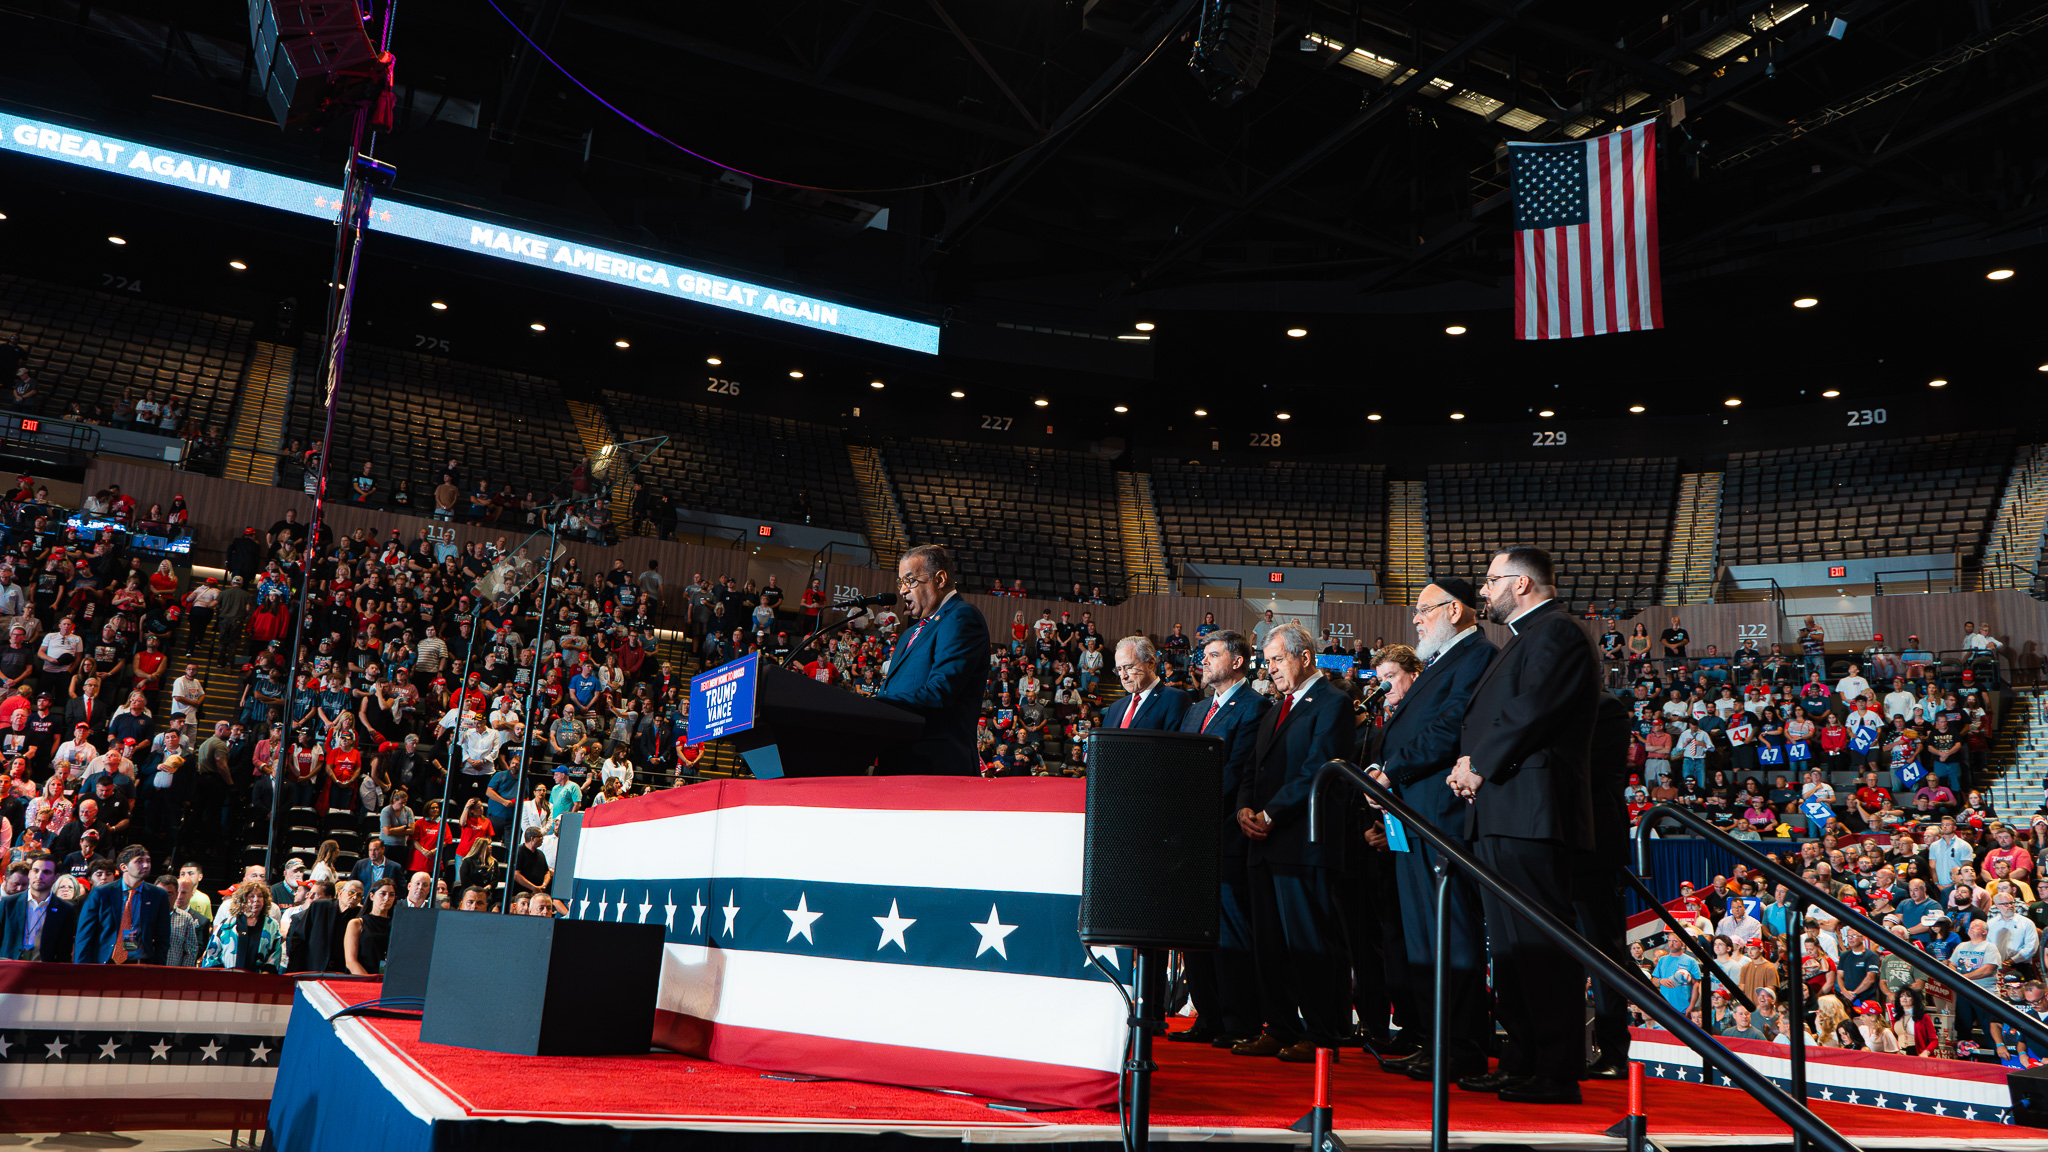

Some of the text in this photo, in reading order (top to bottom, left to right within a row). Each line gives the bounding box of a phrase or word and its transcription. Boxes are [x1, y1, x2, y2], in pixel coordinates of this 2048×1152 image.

[14, 124, 231, 189] GREAT AGAIN
[470, 226, 838, 326] MAKE AMERICA GREAT AGAIN
[707, 377, 740, 396] 226
[981, 415, 1013, 431] 227
[1847, 408, 1887, 427] 230
[22, 419, 39, 431] EXIT
[1249, 433, 1281, 447] 228
[1532, 431, 1567, 447] 229
[759, 525, 772, 537] EXIT
[1270, 572, 1283, 582] EXIT
[1830, 566, 1845, 577] EXIT
[834, 585, 859, 598] 120
[1329, 623, 1354, 635] 121
[1739, 624, 1767, 636] 122
[706, 681, 737, 708] TRUMP
[708, 701, 732, 722] VANCE
[1733, 728, 1749, 741] 47
[1855, 728, 1871, 750] 47
[1761, 748, 1778, 761] 47
[1790, 743, 1805, 757] 47
[1903, 762, 1920, 781] 47
[1806, 803, 1831, 819] 47
[1924, 982, 1950, 996] SWAMP
